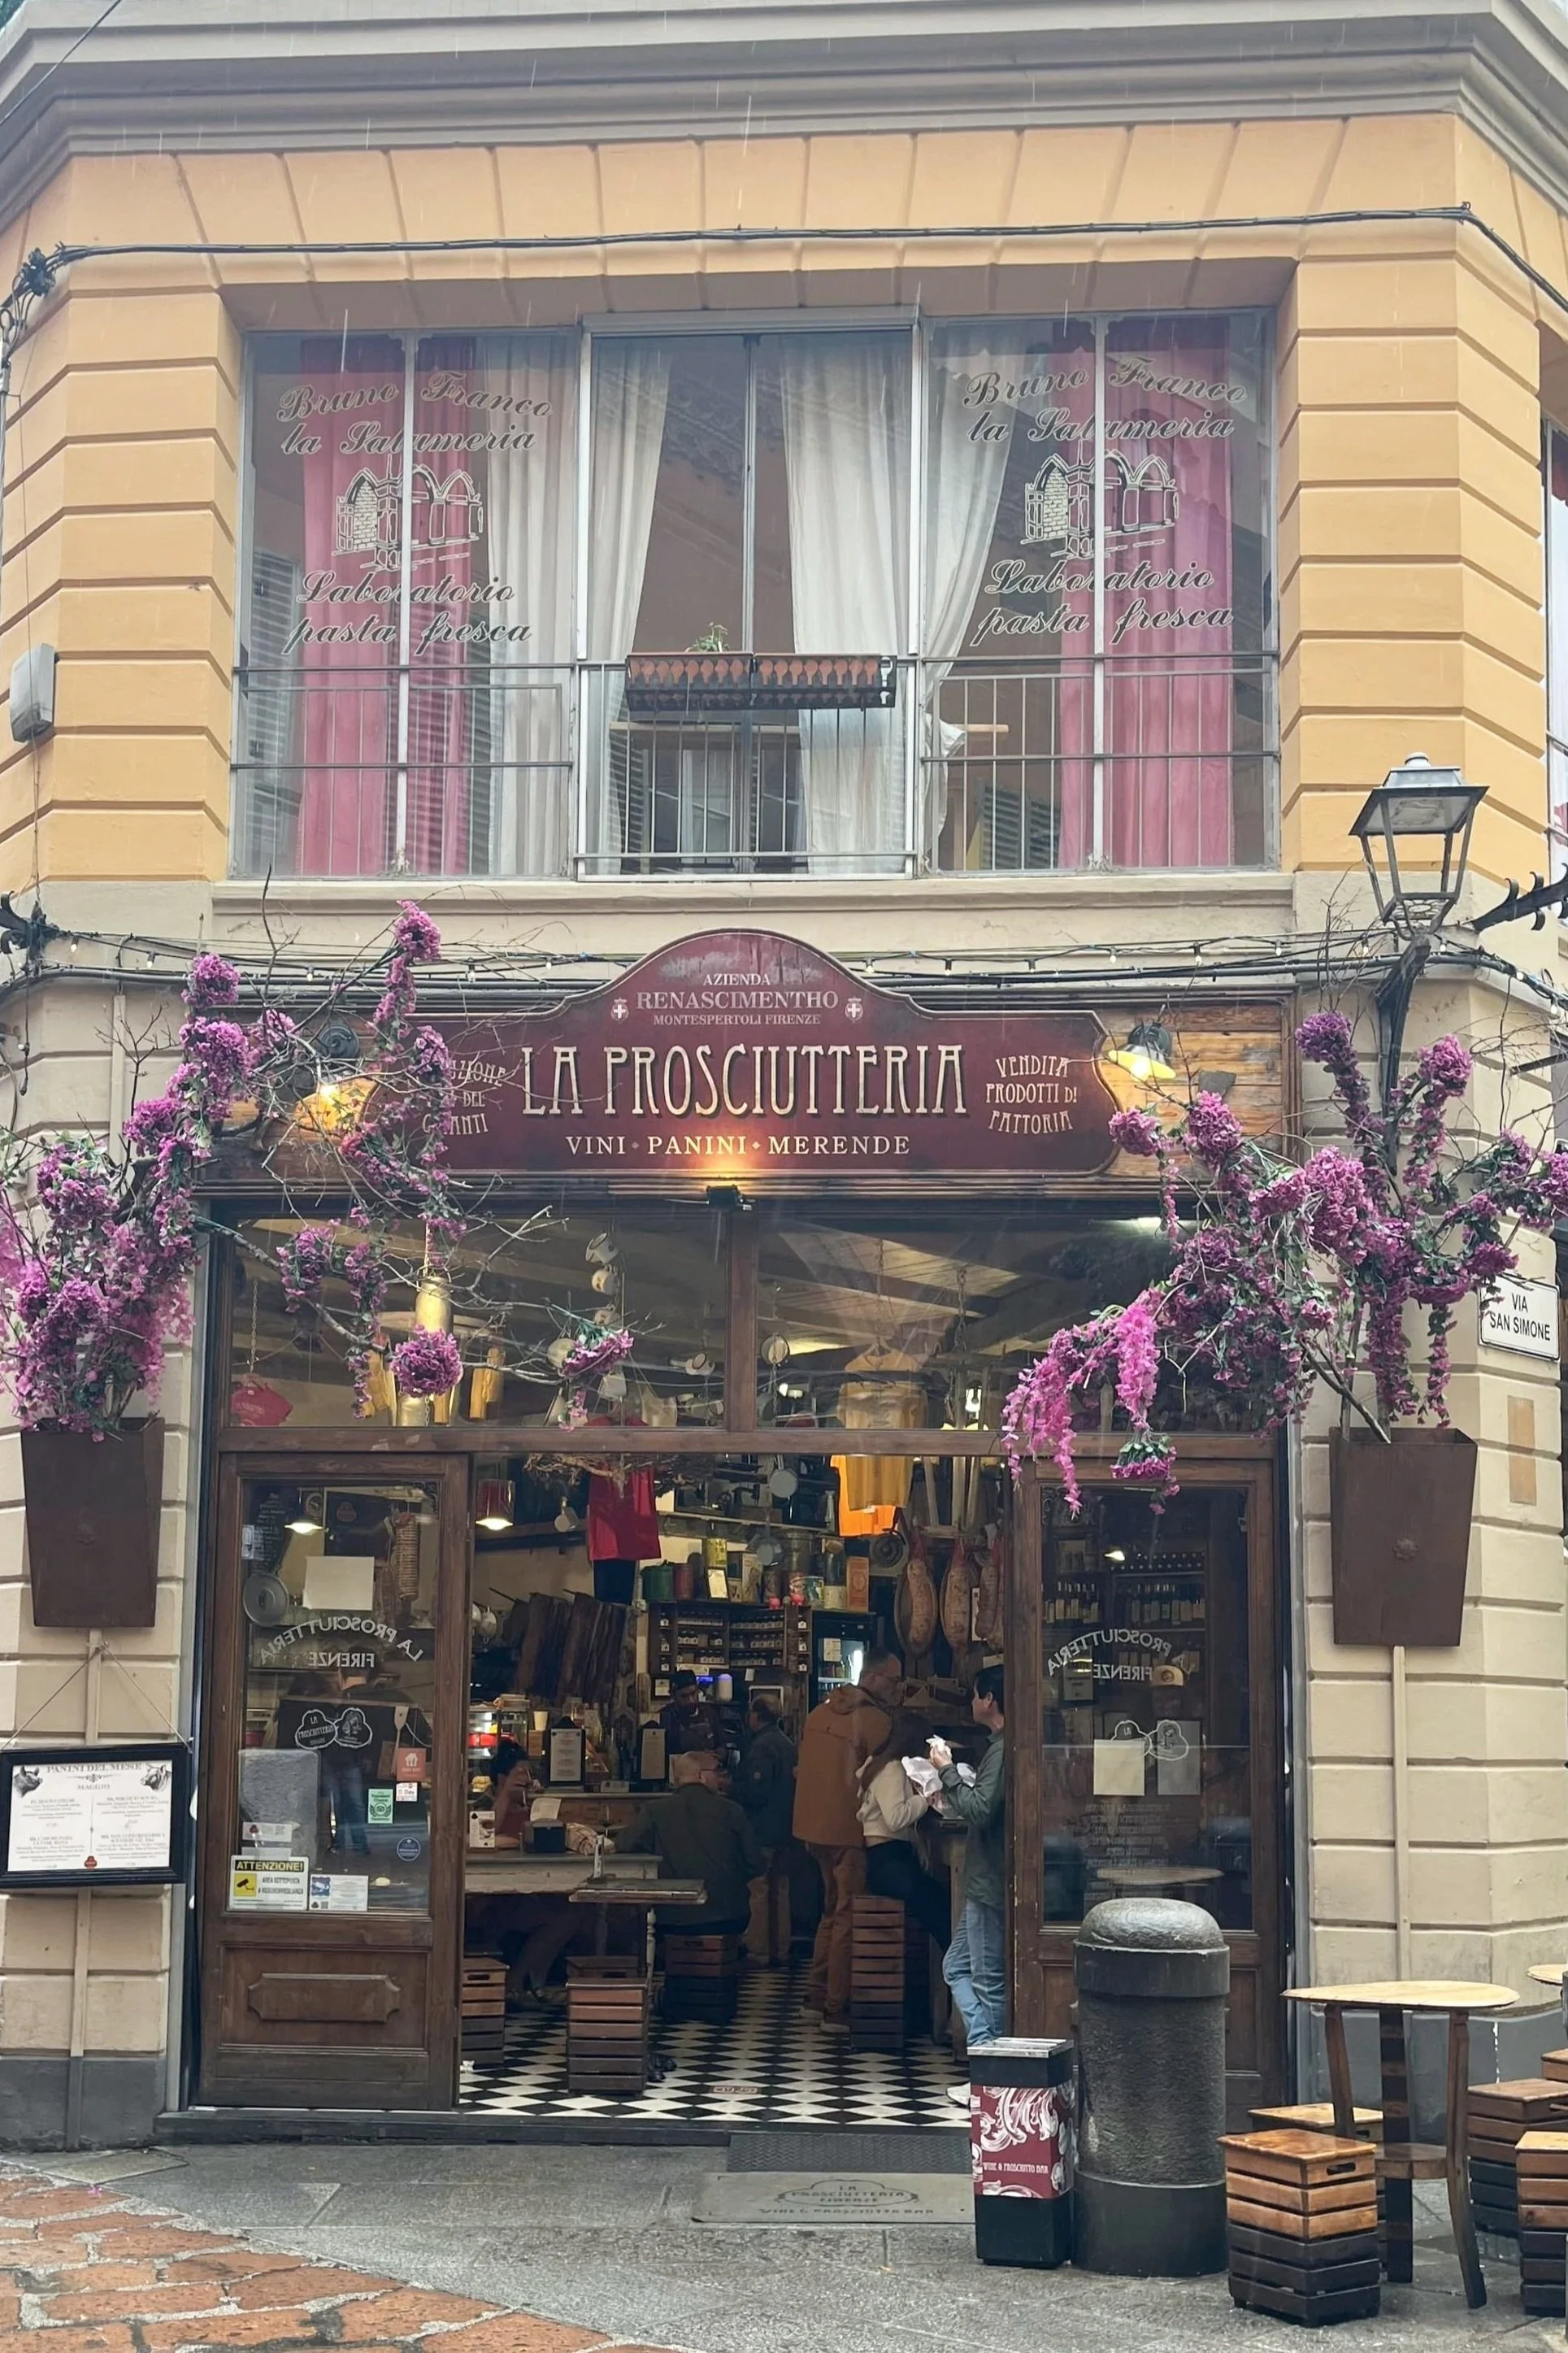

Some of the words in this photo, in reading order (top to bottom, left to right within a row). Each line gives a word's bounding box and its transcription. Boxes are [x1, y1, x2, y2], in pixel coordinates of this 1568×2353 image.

[962, 368, 1089, 407] Bruno
[1110, 354, 1247, 403] Franco
[277, 383, 399, 422] Bruno
[420, 370, 553, 417] Franco
[280, 423, 322, 455] la
[967, 410, 1008, 443] la
[280, 613, 397, 655] pasta
[415, 611, 532, 656] fresca
[970, 603, 1089, 646] pasta
[1109, 598, 1234, 646] fresca
[703, 973, 771, 986] AZIENDA
[636, 990, 839, 1010] RENASCIMENTHO
[654, 1014, 762, 1026] MONTESPERTOLI
[765, 1014, 822, 1025] FIRENZE
[521, 1046, 584, 1116] LA
[603, 1042, 967, 1116] PROSCIUTTERIA
[995, 1055, 1070, 1078] VENDITA
[985, 1082, 1060, 1103] PRODOTTI
[988, 1110, 1074, 1135] FATTORIA
[566, 1136, 626, 1155] VINI
[647, 1136, 747, 1155] PANINI
[768, 1135, 910, 1155] MERENDE
[1511, 1293, 1528, 1312] VIA
[1489, 1312, 1510, 1332] SAN
[1513, 1316, 1551, 1342] SIMONE
[237, 1860, 303, 1872] ATTENZIONE!
